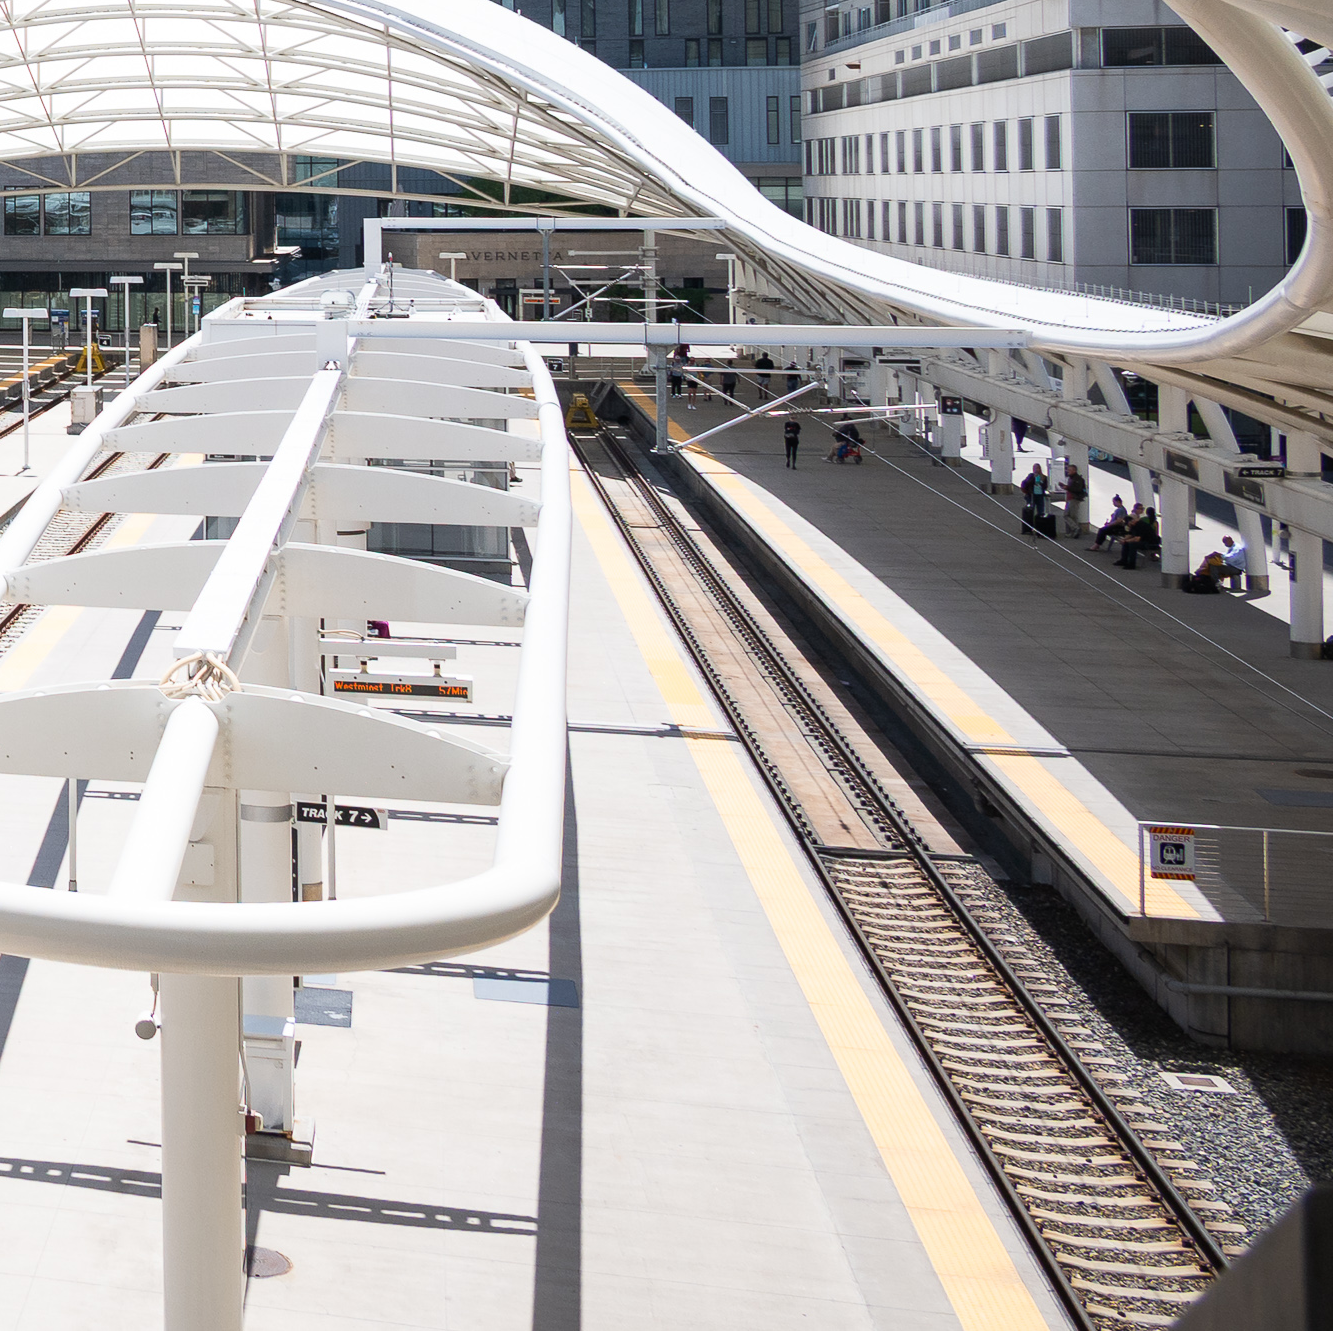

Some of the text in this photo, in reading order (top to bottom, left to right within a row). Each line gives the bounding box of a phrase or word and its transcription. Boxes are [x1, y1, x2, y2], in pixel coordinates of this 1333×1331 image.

[1277, 469, 1283, 477] 7
[301, 807, 359, 823] TRAK 7
[1153, 834, 1191, 843] DANGER
